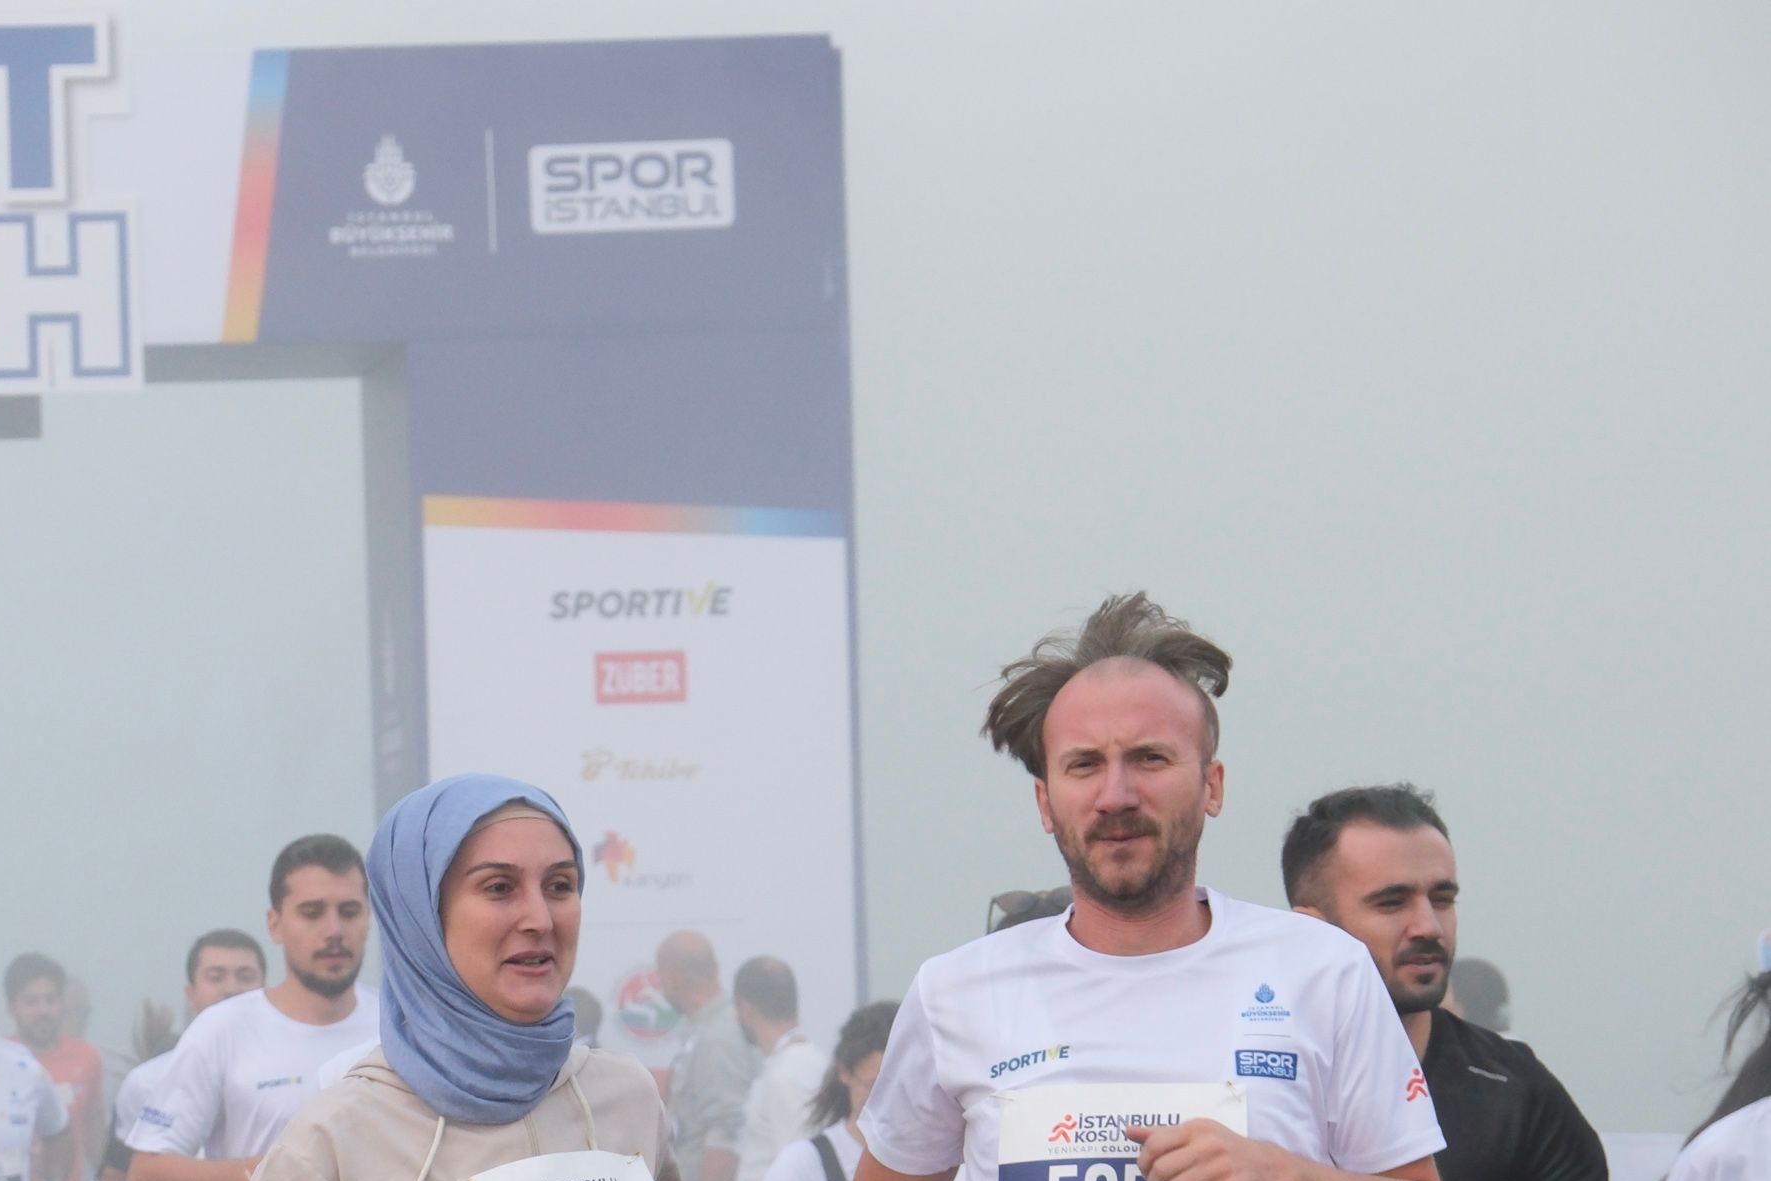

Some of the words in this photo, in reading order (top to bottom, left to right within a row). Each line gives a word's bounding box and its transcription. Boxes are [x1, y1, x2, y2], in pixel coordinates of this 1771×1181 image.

[544, 151, 718, 193] SPOR
[549, 580, 732, 621] SPORTIVE
[990, 1045, 1070, 1078] SPORTIVE
[1239, 1051, 1294, 1069] SPOR
[1078, 1113, 1180, 1128] İSTANBULU
